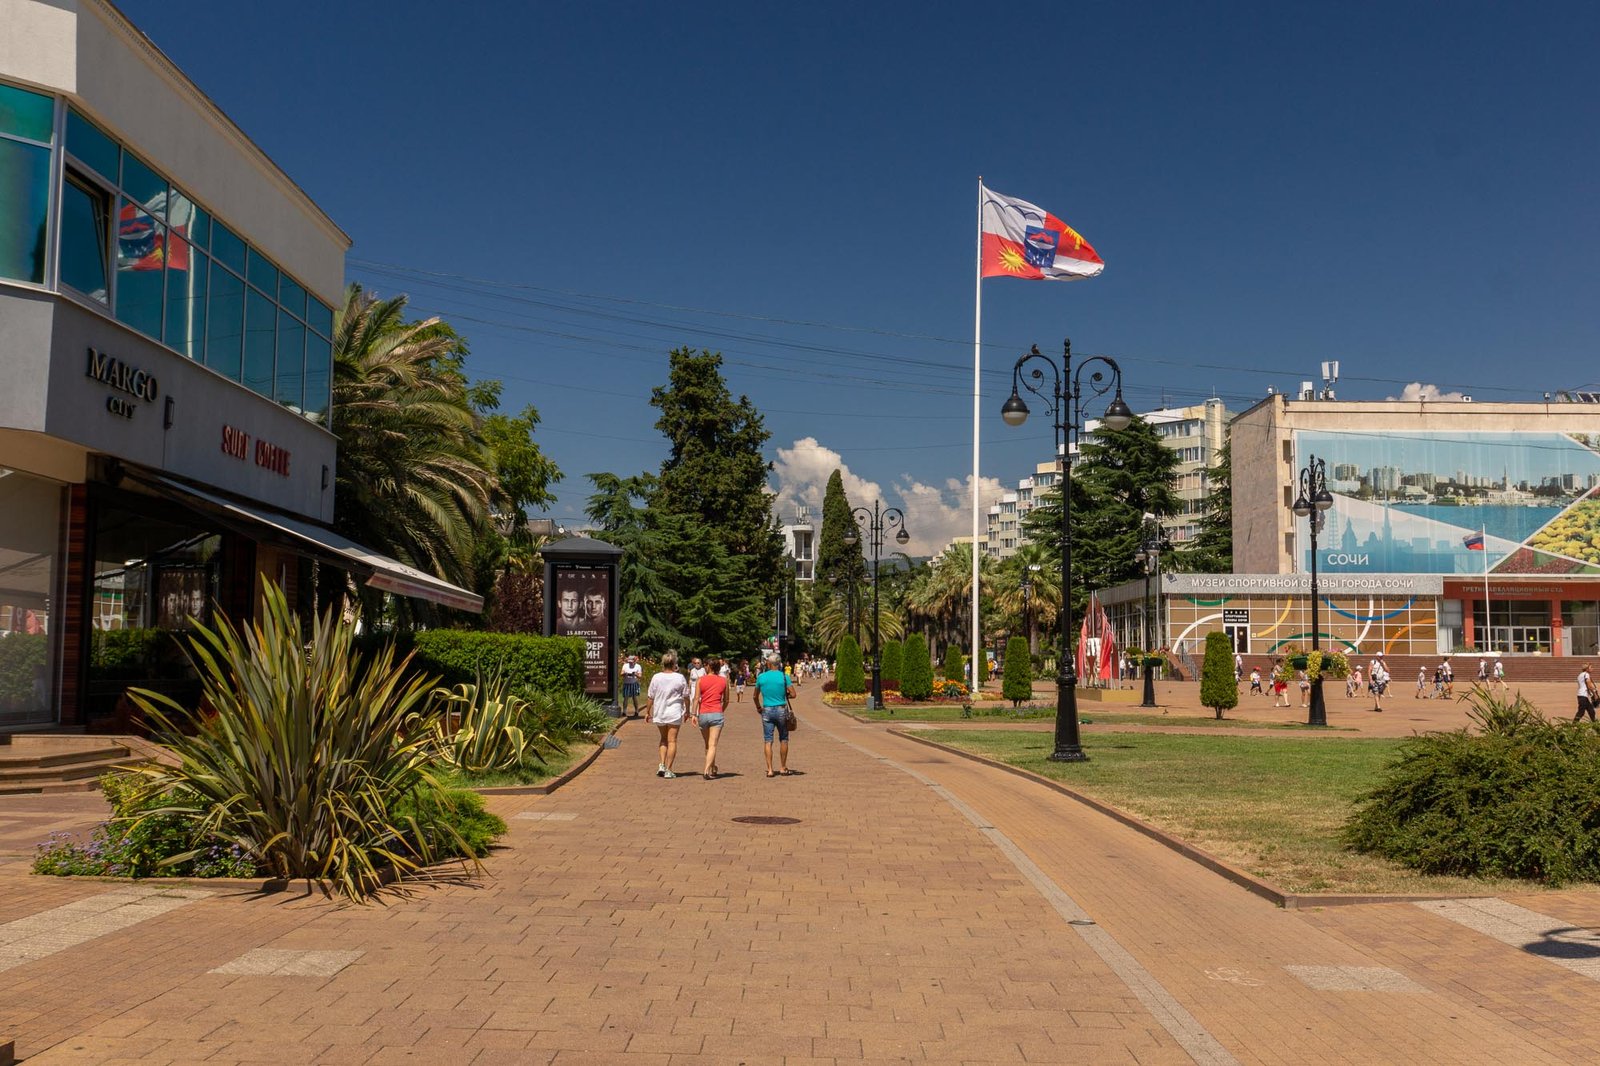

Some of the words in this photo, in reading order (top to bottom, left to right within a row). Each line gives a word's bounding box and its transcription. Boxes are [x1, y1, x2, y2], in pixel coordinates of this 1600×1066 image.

[87, 347, 157, 403] MARGO
[108, 397, 137, 419] CITY
[222, 425, 250, 461] SURF
[1327, 553, 1369, 565] СОЧИ
[1191, 578, 1226, 588] МУЗЕЙ
[1228, 578, 1299, 588] СПОРТИВНОЙ
[1341, 579, 1382, 589] ГОРОДА
[1385, 579, 1414, 588] СОЧИ
